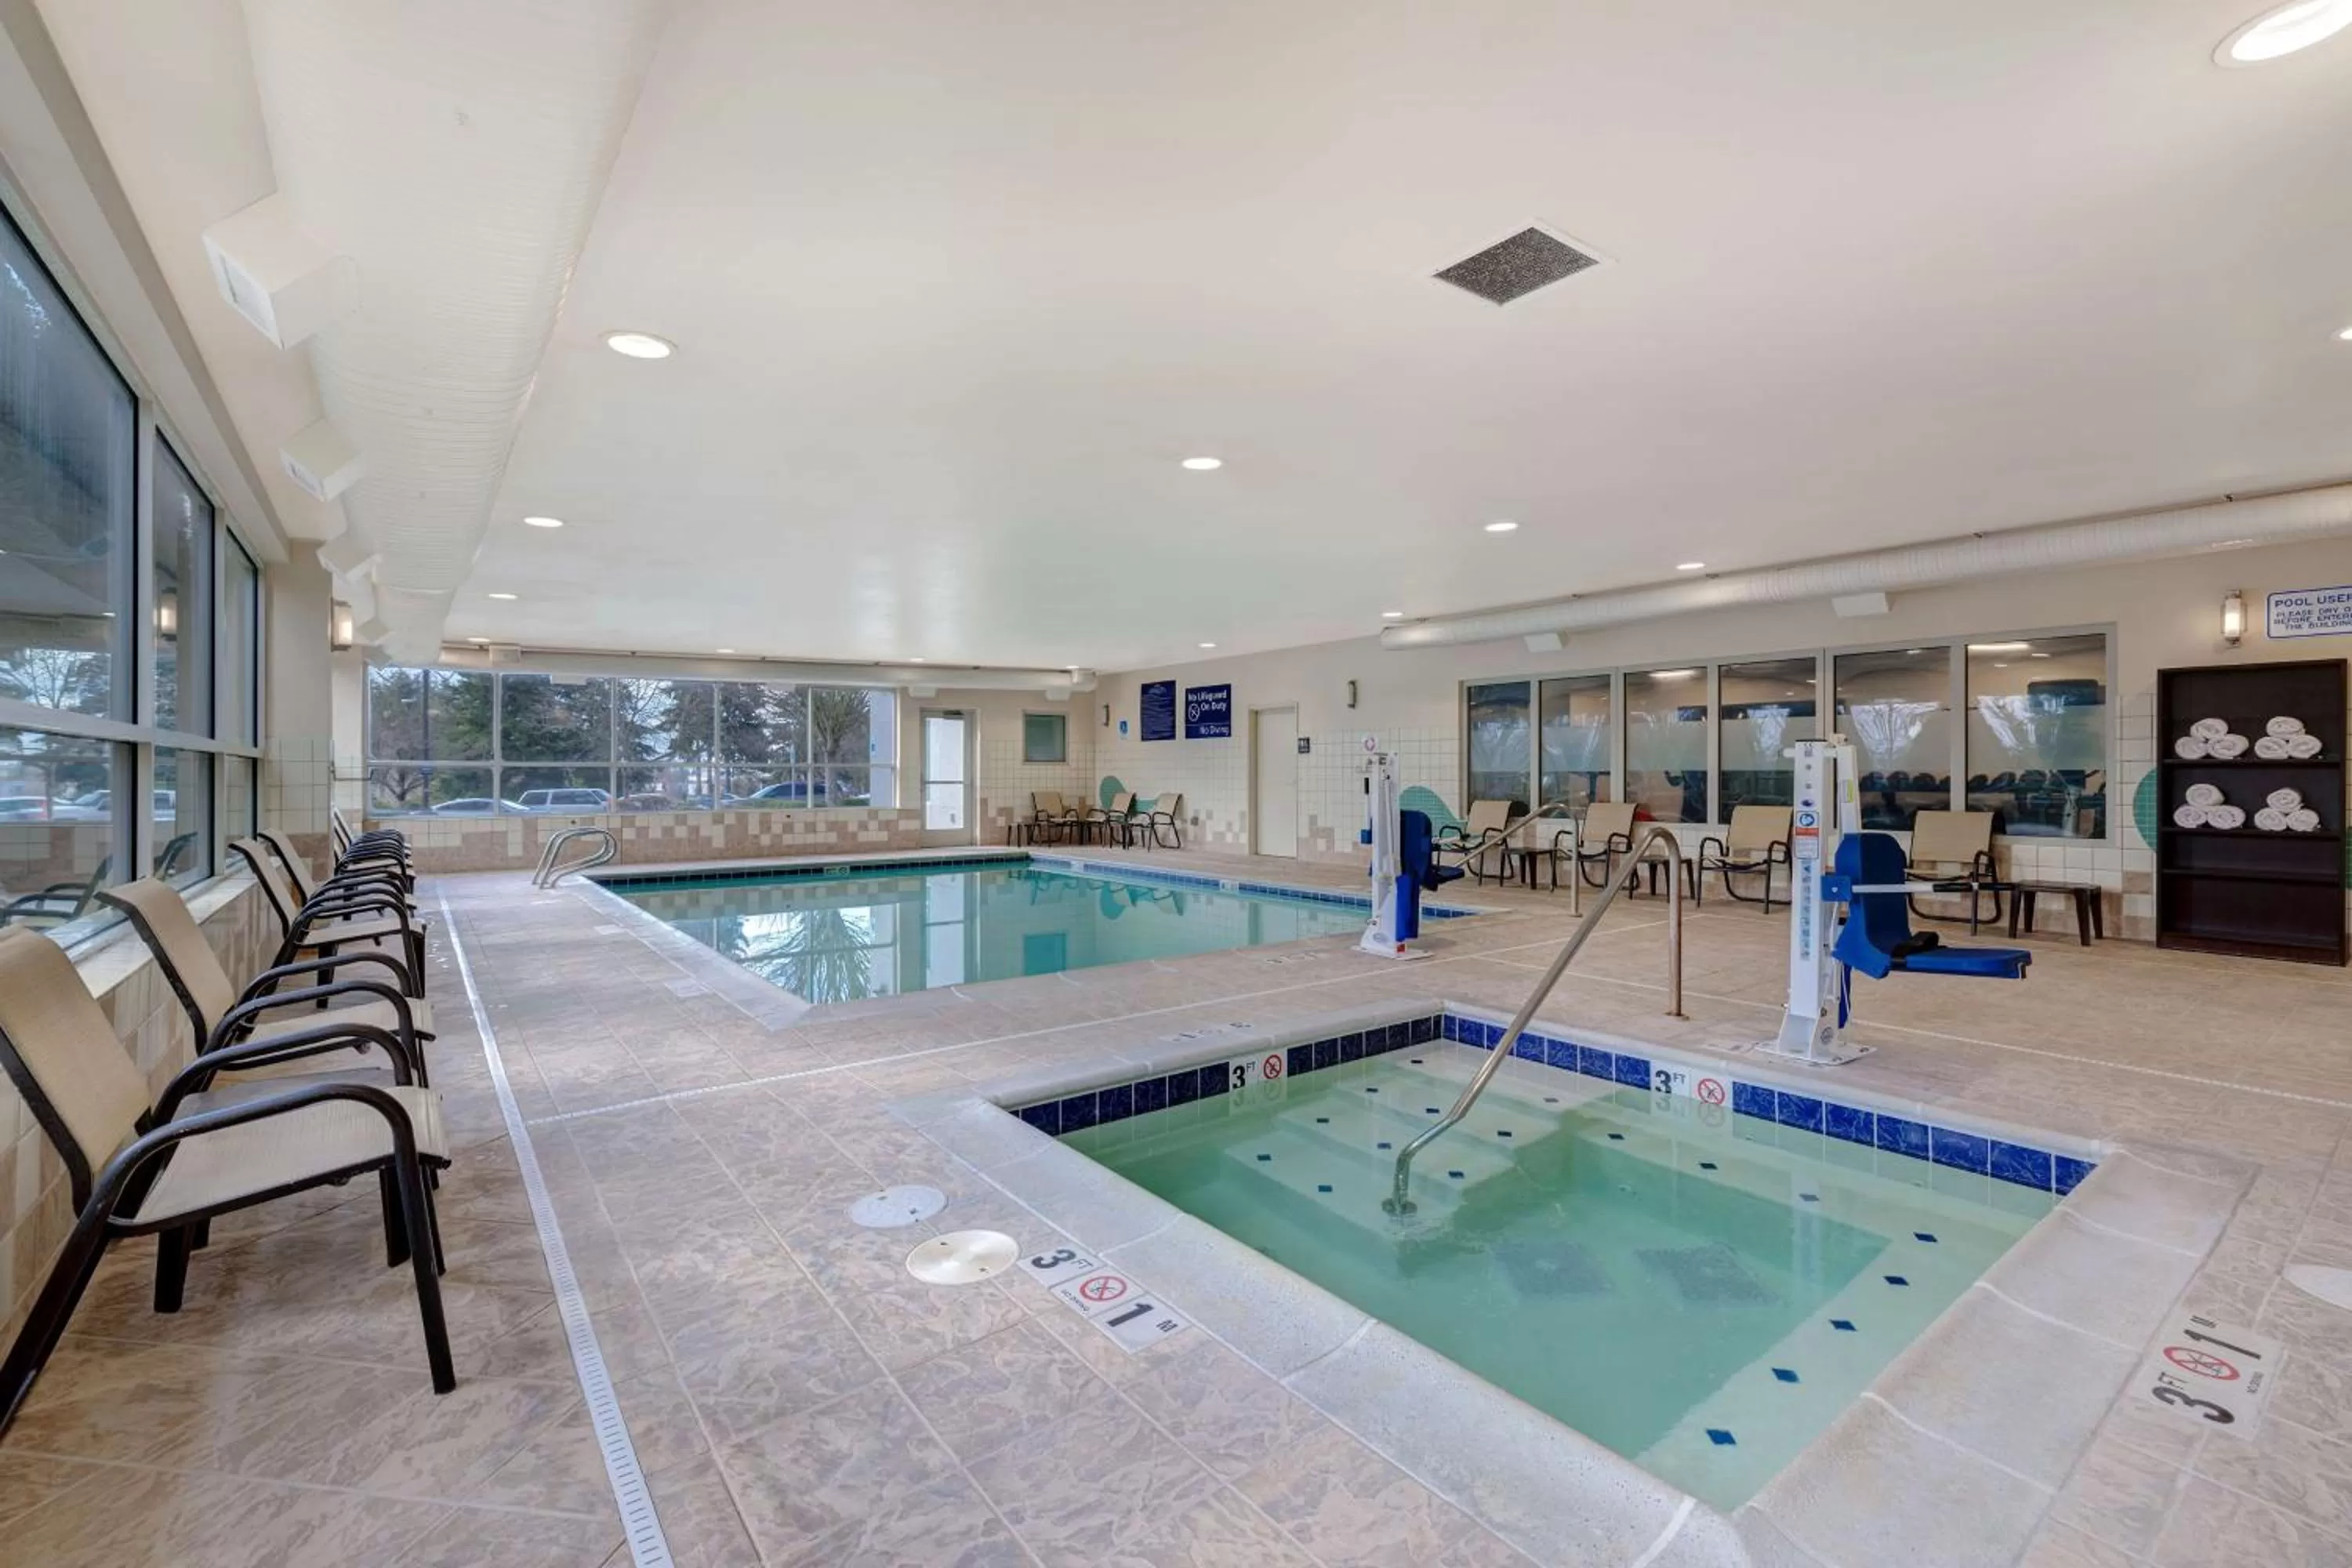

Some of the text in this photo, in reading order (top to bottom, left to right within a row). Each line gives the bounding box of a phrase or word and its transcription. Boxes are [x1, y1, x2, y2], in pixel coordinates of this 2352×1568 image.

[2274, 597, 2314, 608] POOL
[1188, 690, 1227, 702] No Lifeguard
[1201, 702, 1227, 712] On Duty
[1200, 725, 1229, 736] No Diving
[1232, 1062, 1256, 1089] 3 FT
[1655, 1069, 1686, 1094] 3 FT
[1032, 1248, 1094, 1270] 3 FT
[1105, 1302, 1154, 1327] 1
[2183, 1328, 2262, 1360] 1
[2152, 1385, 2235, 1425] 3
